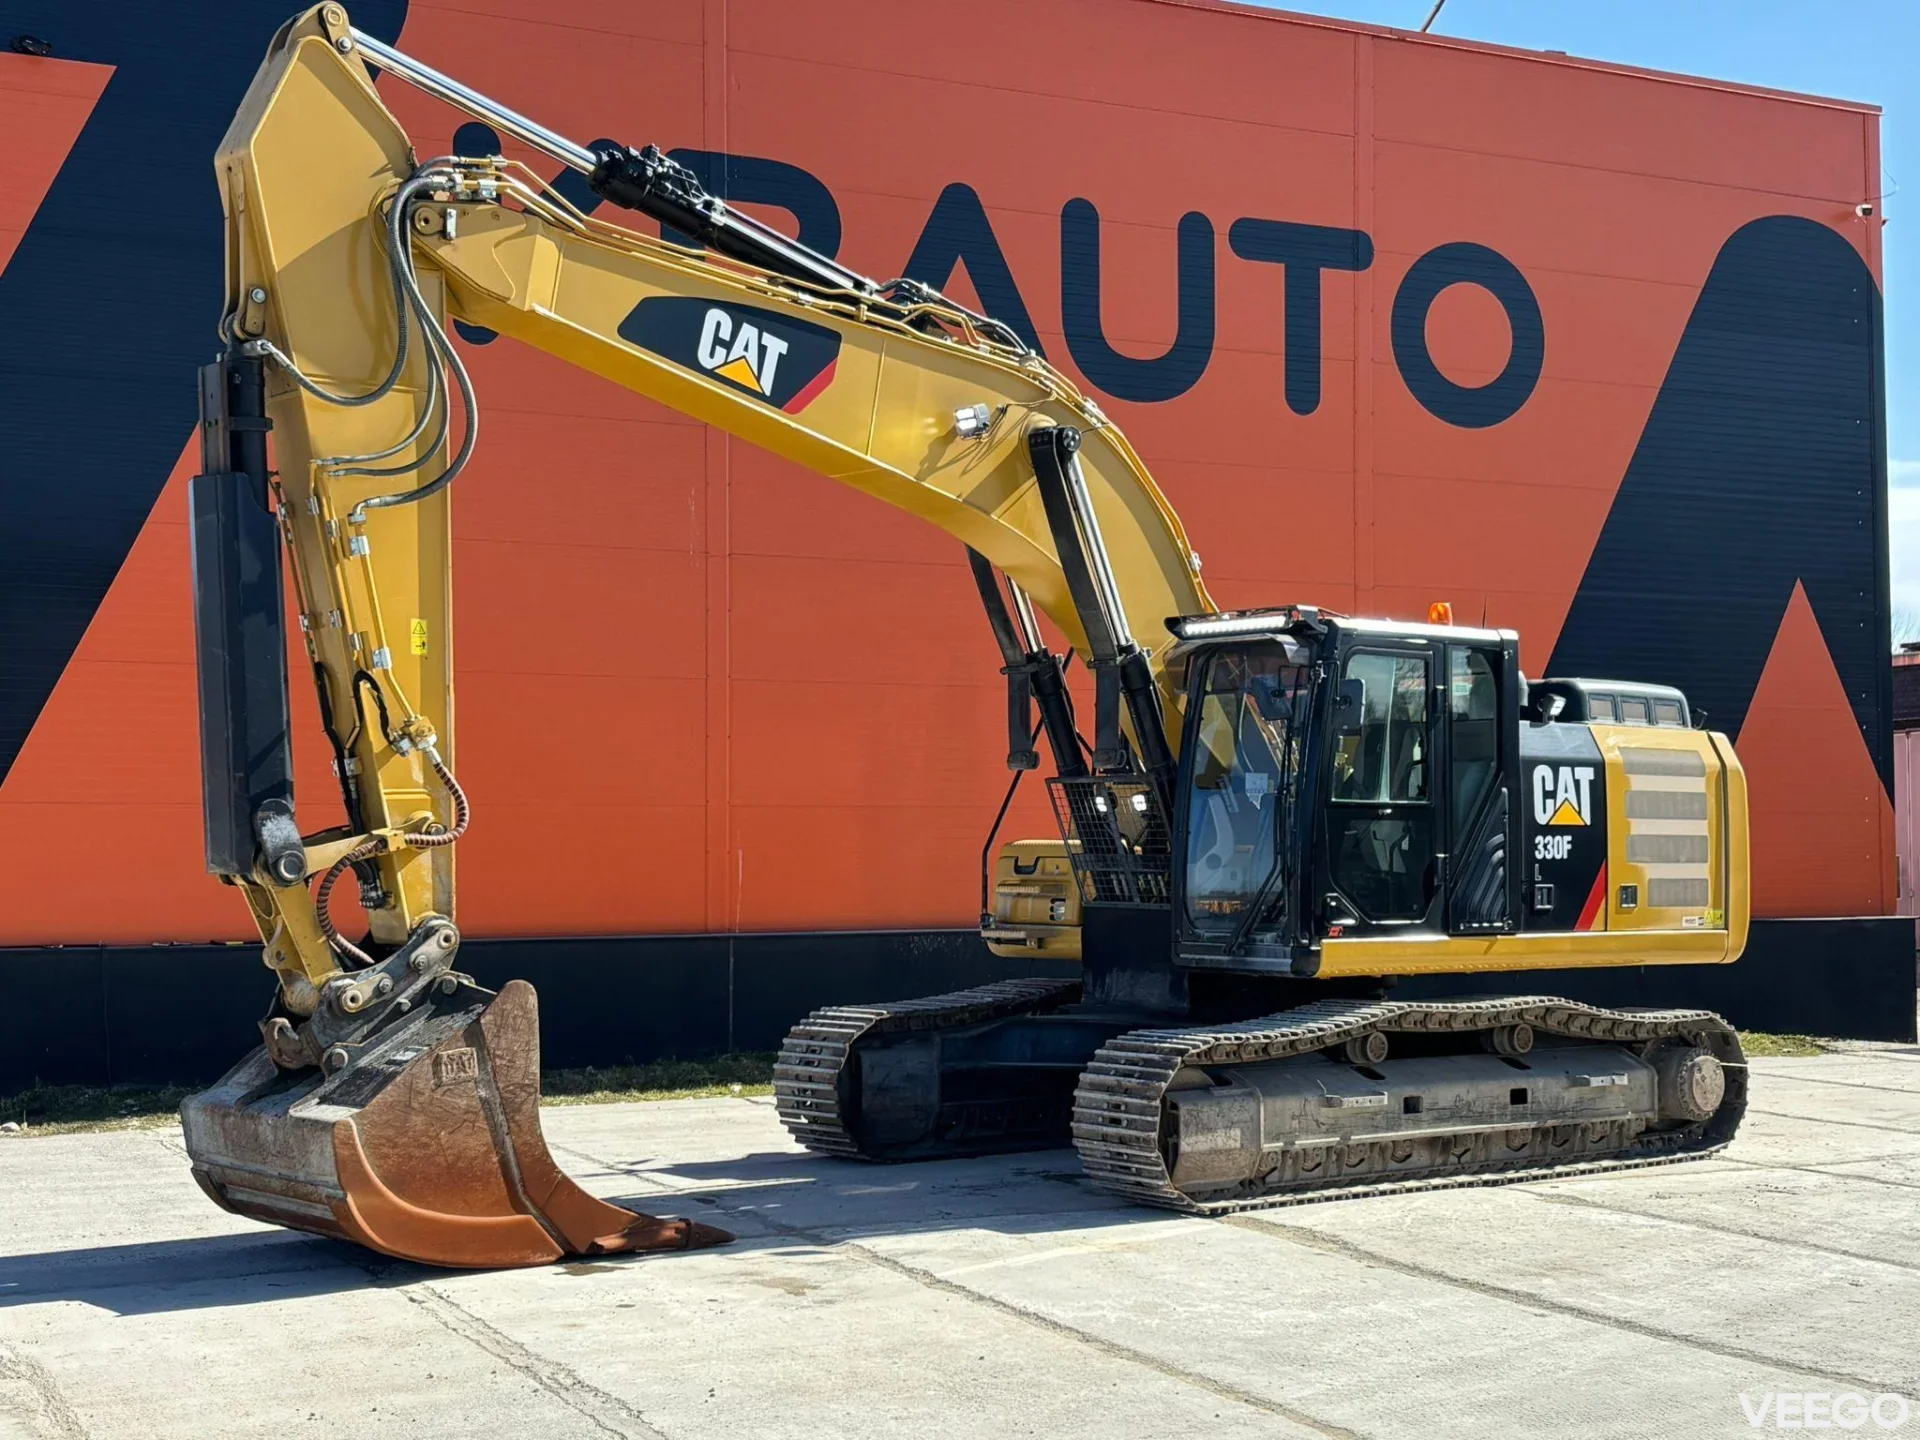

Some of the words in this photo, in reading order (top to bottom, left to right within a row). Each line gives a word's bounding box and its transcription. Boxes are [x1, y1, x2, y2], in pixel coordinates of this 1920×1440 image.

[697, 308, 788, 398] CAT
[1533, 764, 1595, 827] CAT
[1534, 835, 1572, 860] 330F
